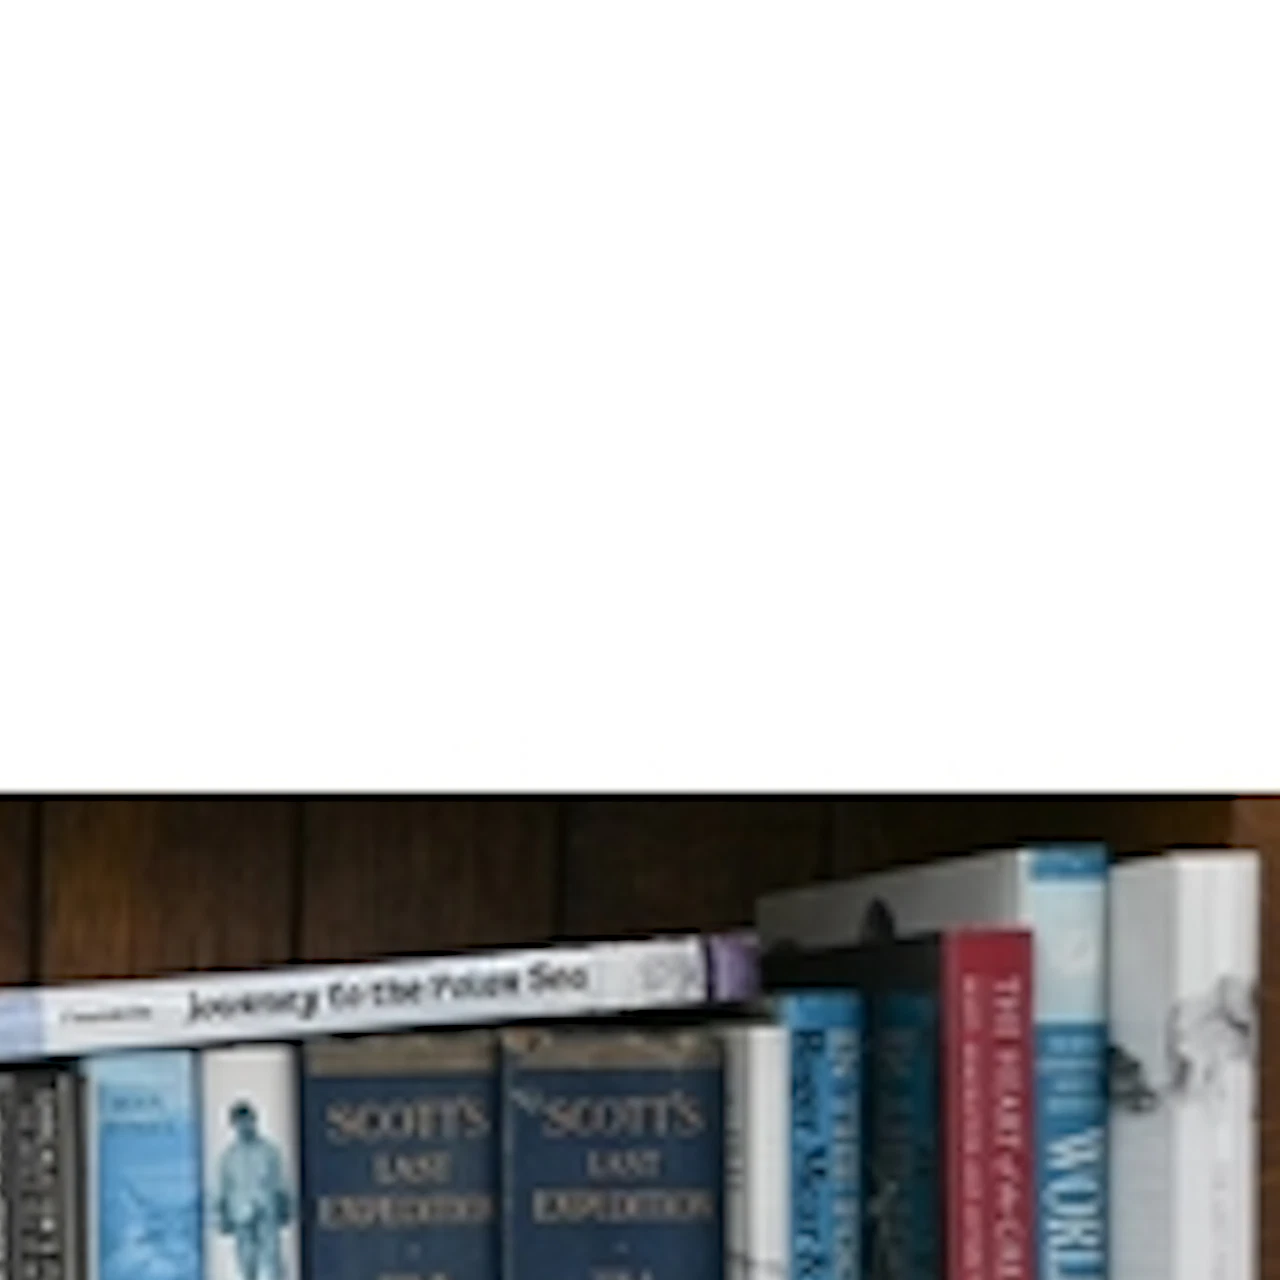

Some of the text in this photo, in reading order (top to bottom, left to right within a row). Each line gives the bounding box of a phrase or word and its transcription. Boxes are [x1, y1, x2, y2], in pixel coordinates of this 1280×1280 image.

[185, 984, 317, 1023] Journey
[527, 963, 589, 993] Sea
[994, 974, 1022, 1039] THE
[793, 1028, 828, 1135] Roger
[994, 1049, 1023, 1147] HEART
[325, 1096, 489, 1142] SCOTT'S
[543, 1092, 705, 1138] SCOTT'S
[372, 1150, 453, 1184] LAST
[586, 1148, 662, 1179] LAST
[532, 1189, 714, 1224] EXPEDITION
